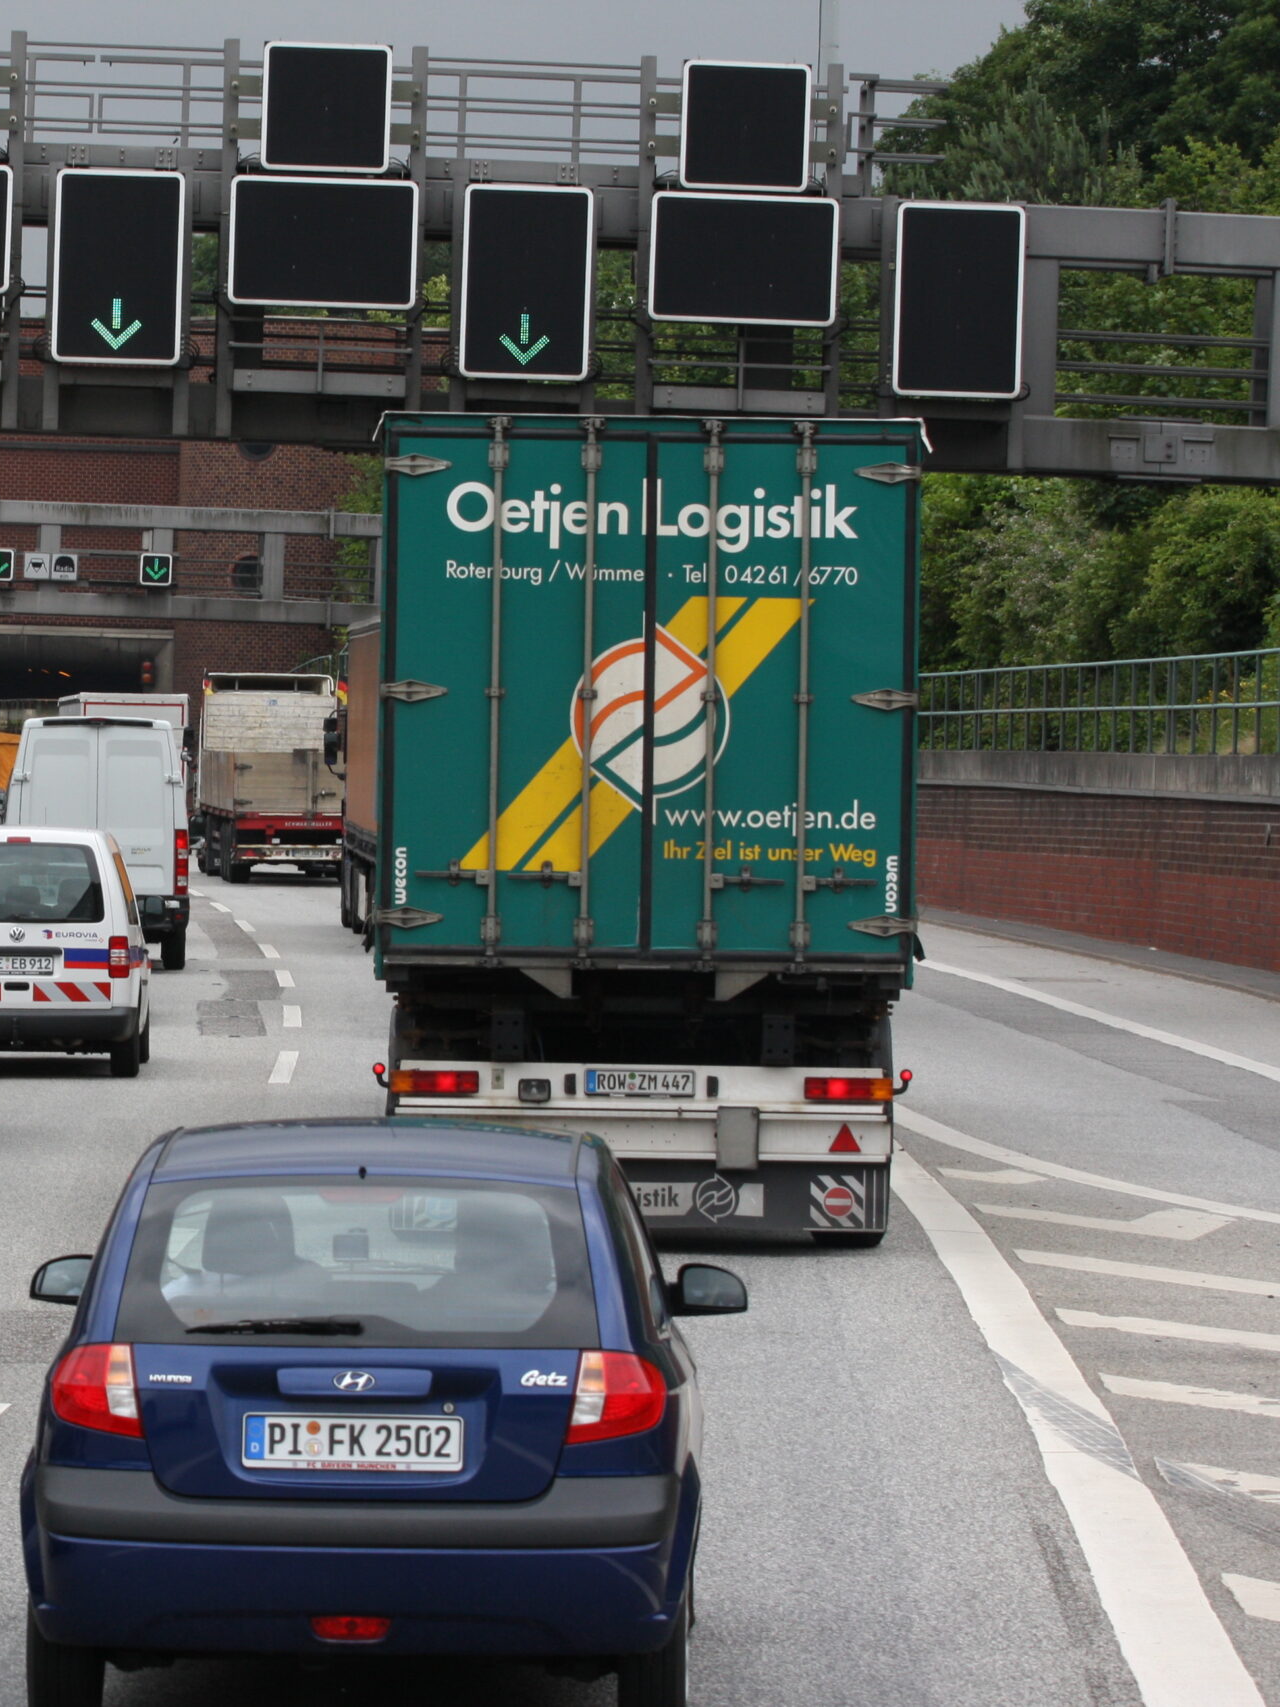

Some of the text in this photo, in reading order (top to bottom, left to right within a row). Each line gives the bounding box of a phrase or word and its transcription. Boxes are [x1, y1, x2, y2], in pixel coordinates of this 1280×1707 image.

[447, 478, 859, 553] Oetjen Logistik
[808, 566, 858, 585] 6770
[664, 799, 876, 837] www.oetjen.de
[664, 839, 691, 859] Ihr
[739, 841, 761, 860] ist
[828, 843, 877, 868] Weg
[394, 847, 407, 905] wecon
[885, 855, 898, 913] wecon
[55, 931, 98, 939] EUROVIA
[11, 958, 27, 970] EB
[29, 958, 51, 970] 912
[597, 1073, 691, 1091] ROW ZM 447
[520, 1369, 568, 1387] Getz
[268, 1423, 452, 1458] PI FK 2502
